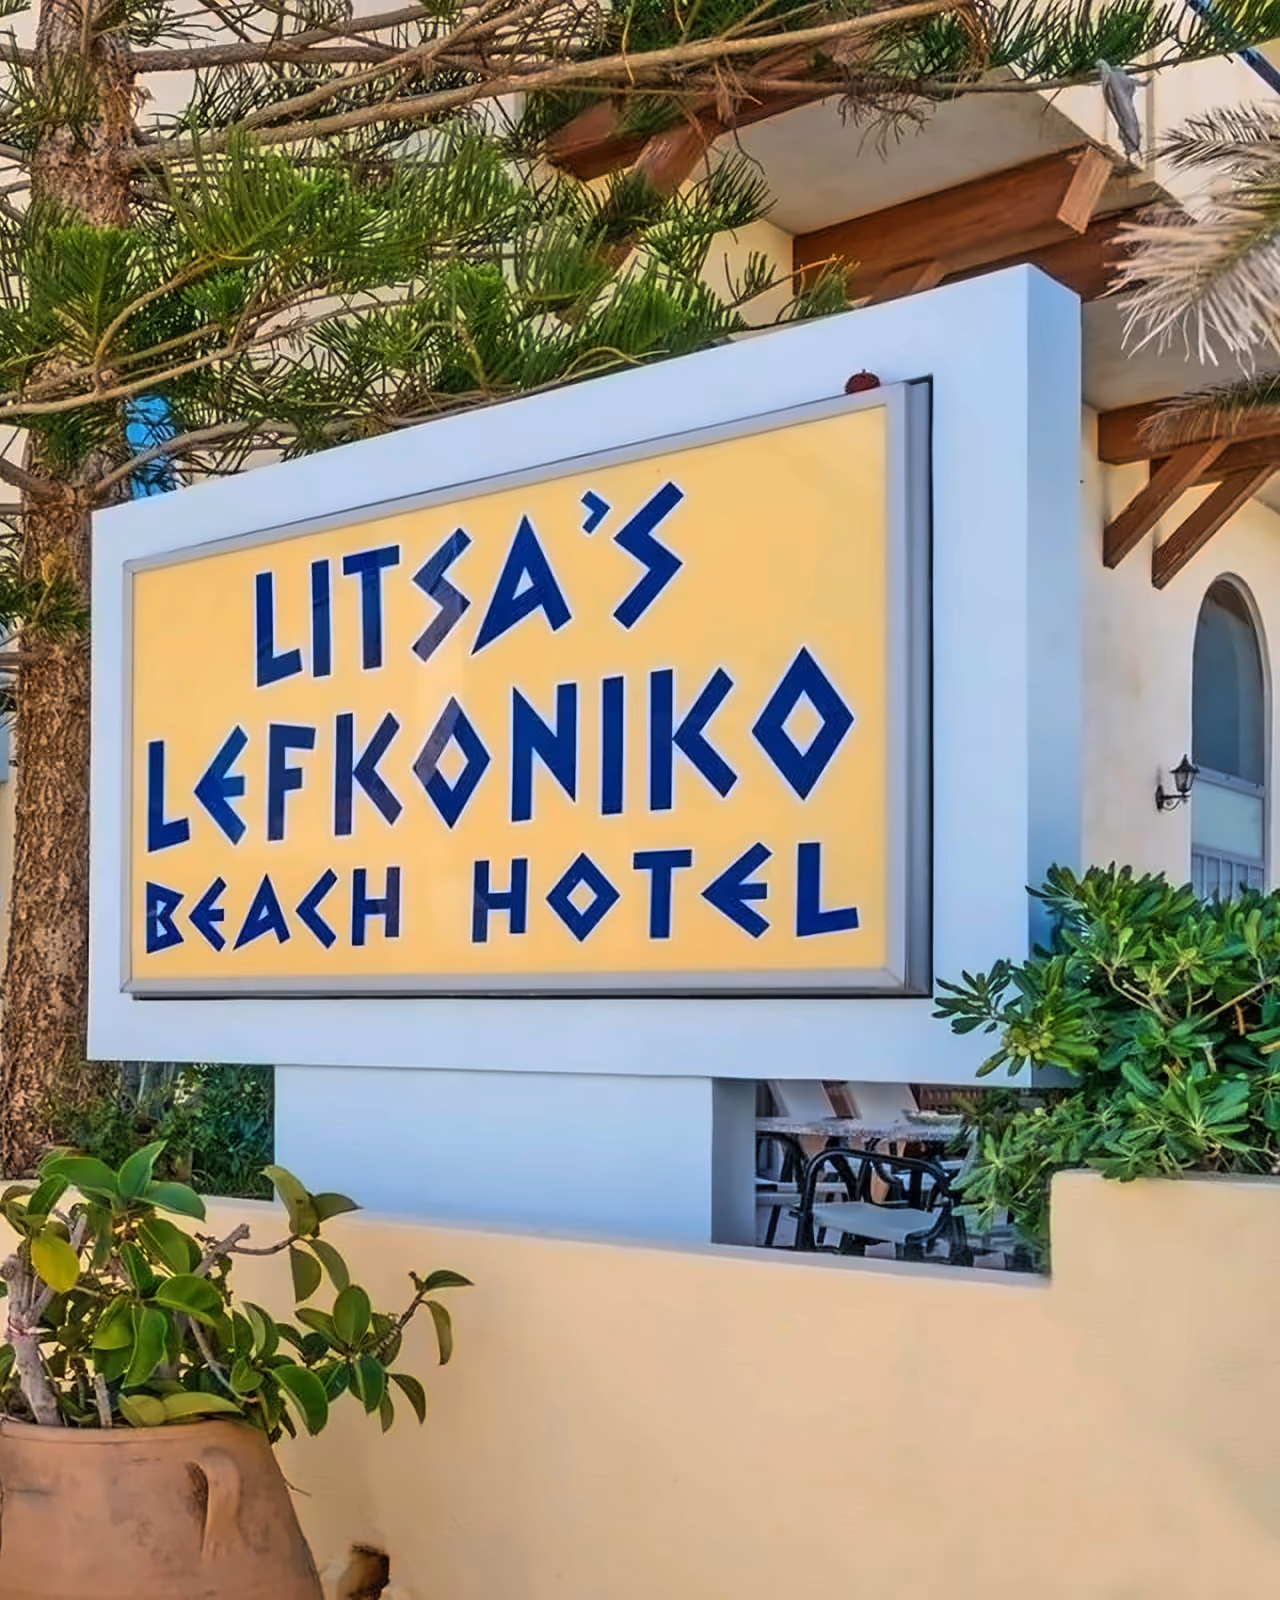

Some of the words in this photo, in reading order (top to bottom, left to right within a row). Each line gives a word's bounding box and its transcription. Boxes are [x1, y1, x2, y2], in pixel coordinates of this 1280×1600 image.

[255, 481, 685, 688] LITSA'S
[146, 646, 855, 854] LEFKONIKO
[146, 865, 401, 955] BEACH
[472, 842, 860, 944] HOTEL
